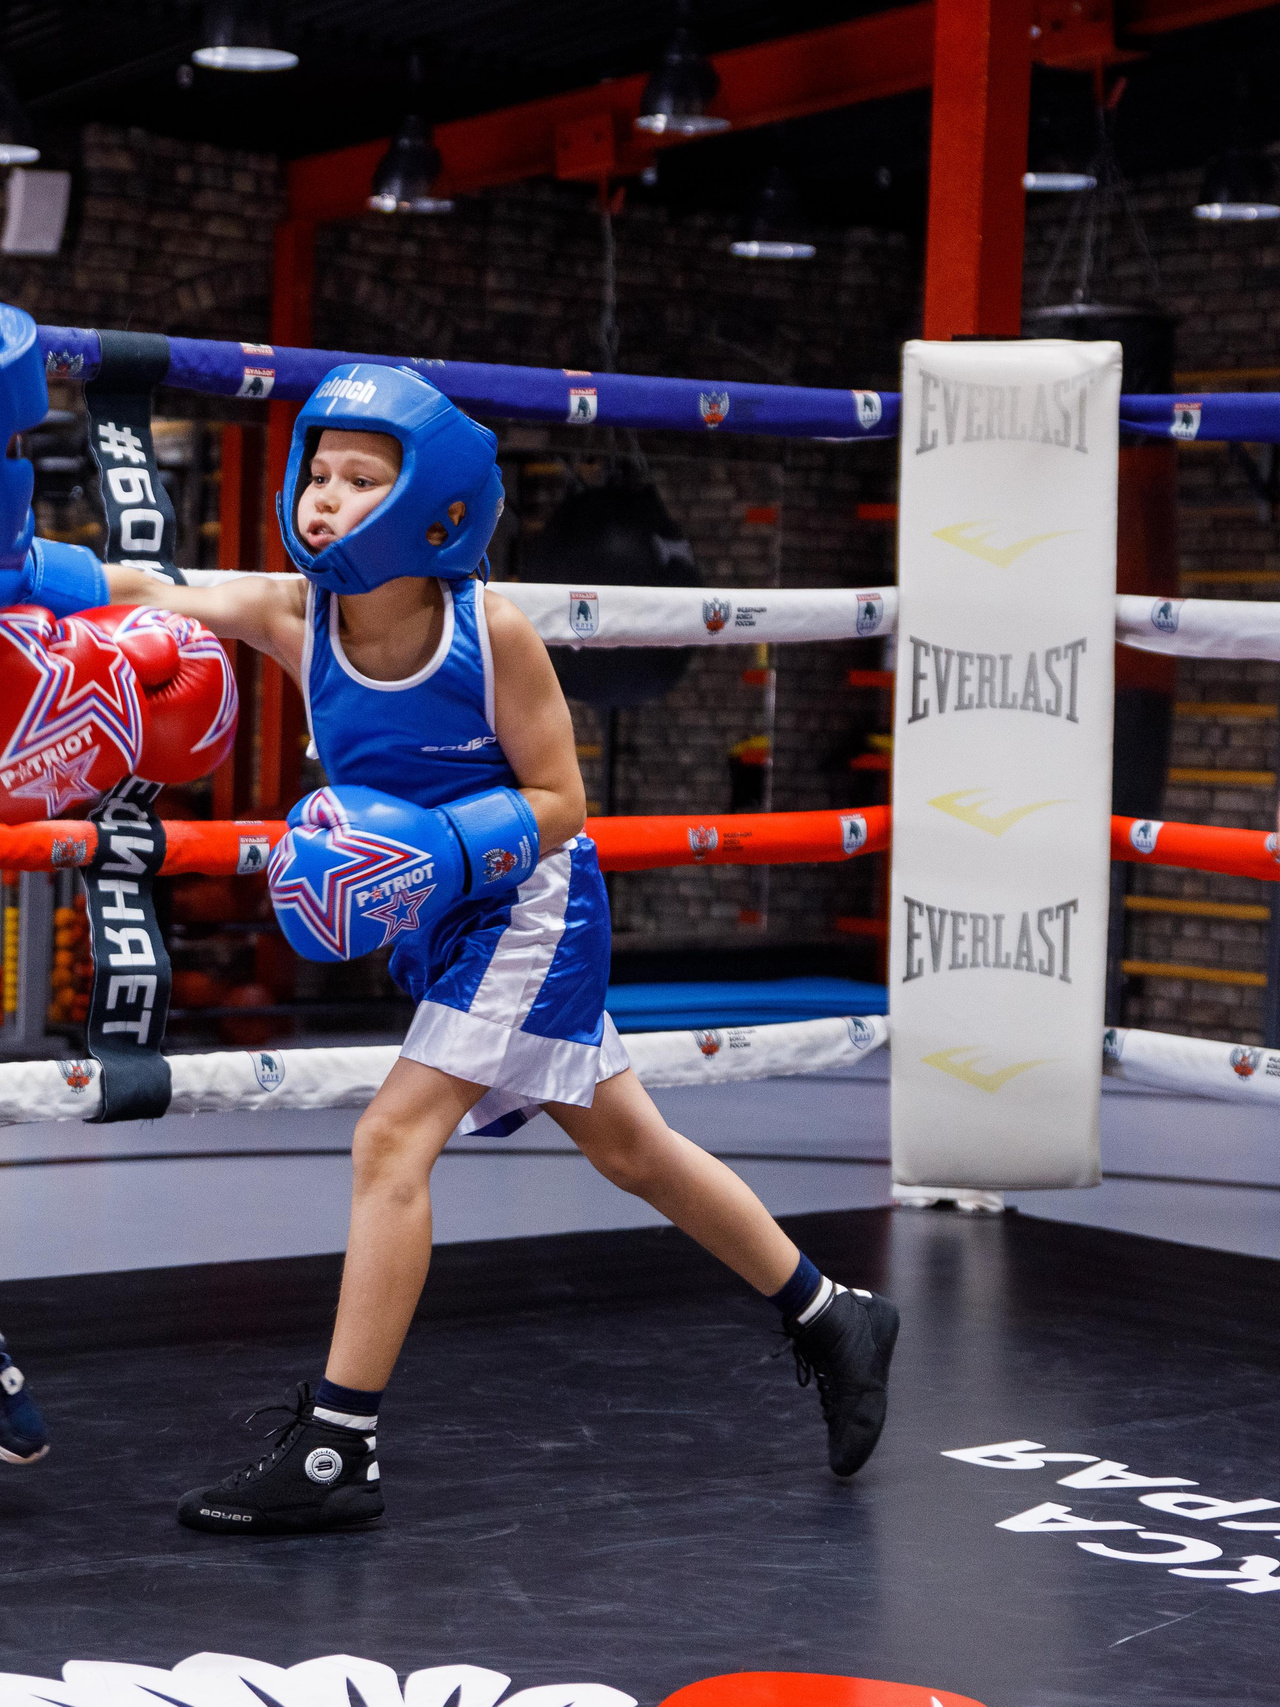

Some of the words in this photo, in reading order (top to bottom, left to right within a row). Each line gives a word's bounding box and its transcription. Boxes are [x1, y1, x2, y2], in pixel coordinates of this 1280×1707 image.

[916, 368, 1097, 456] EVERLAST
[907, 634, 1088, 724] EVERLAST
[902, 895, 1079, 984] EVERLAST
[200, 1508, 252, 1521] BOYBO
